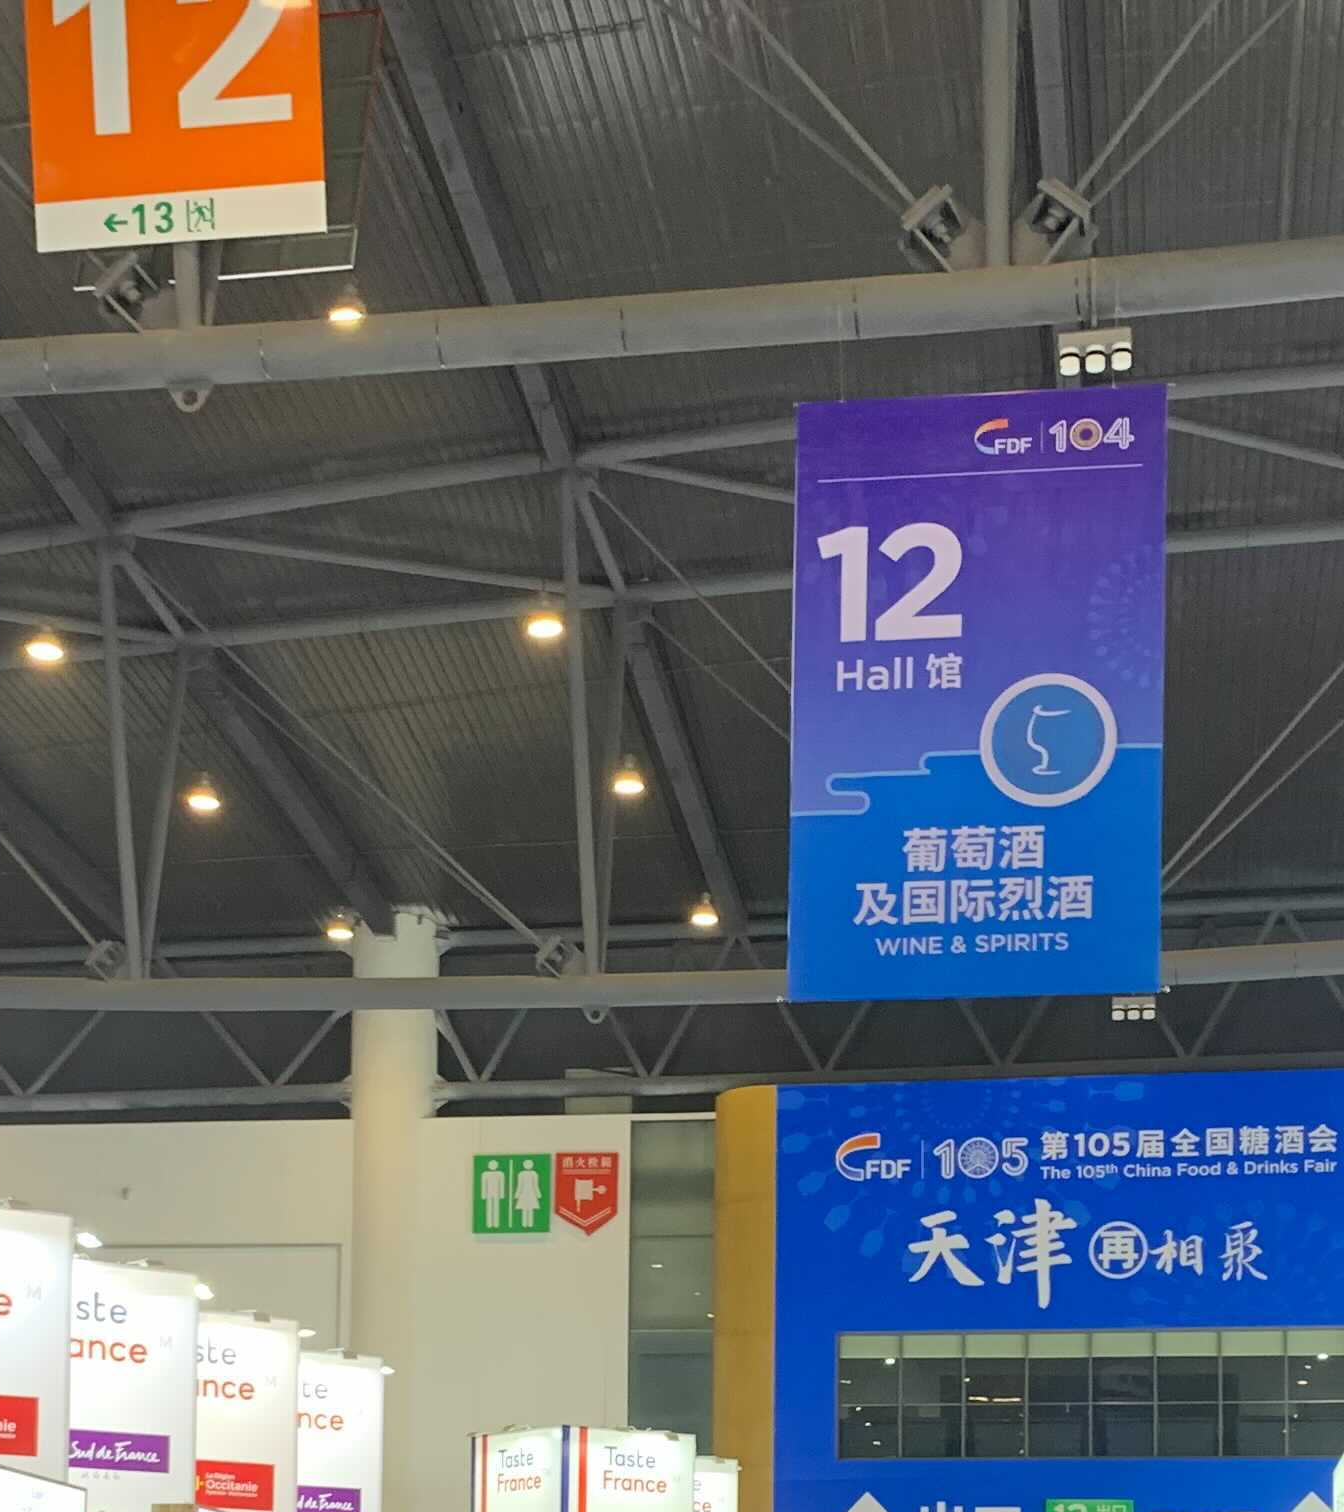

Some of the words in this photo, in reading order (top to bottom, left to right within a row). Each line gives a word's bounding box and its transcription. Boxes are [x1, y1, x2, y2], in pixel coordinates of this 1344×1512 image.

[52, 0, 293, 136] 12
[131, 201, 174, 235] 13
[1049, 416, 1135, 452] 104
[817, 522, 963, 642] 12
[836, 656, 913, 692] Hall
[925, 652, 963, 690] 馆
[902, 824, 1046, 874] 葡萄酒
[853, 875, 1094, 927] 及国际烈酒
[875, 937, 943, 956] WINE
[950, 937, 967, 954] &
[974, 932, 1069, 954] SPIRITS
[933, 1136, 1028, 1180] 105
[1040, 1124, 1338, 1159] 第105届全国糖酒会
[1040, 1165, 1070, 1180] The
[1123, 1162, 1171, 1178] China
[1177, 1160, 1222, 1176] Food
[1227, 1160, 1239, 1175] &
[1244, 1158, 1299, 1174] Drinks
[1304, 1156, 1338, 1172] Fair
[76, 1292, 128, 1324] ste
[69, 1337, 148, 1364] ance
[68, 1440, 96, 1461] Sud
[95, 1445, 114, 1460] de
[113, 1440, 161, 1463] France
[498, 1448, 533, 1468] Taste
[603, 1447, 656, 1469] Taste
[497, 1473, 542, 1494] France
[602, 1470, 667, 1494] France
